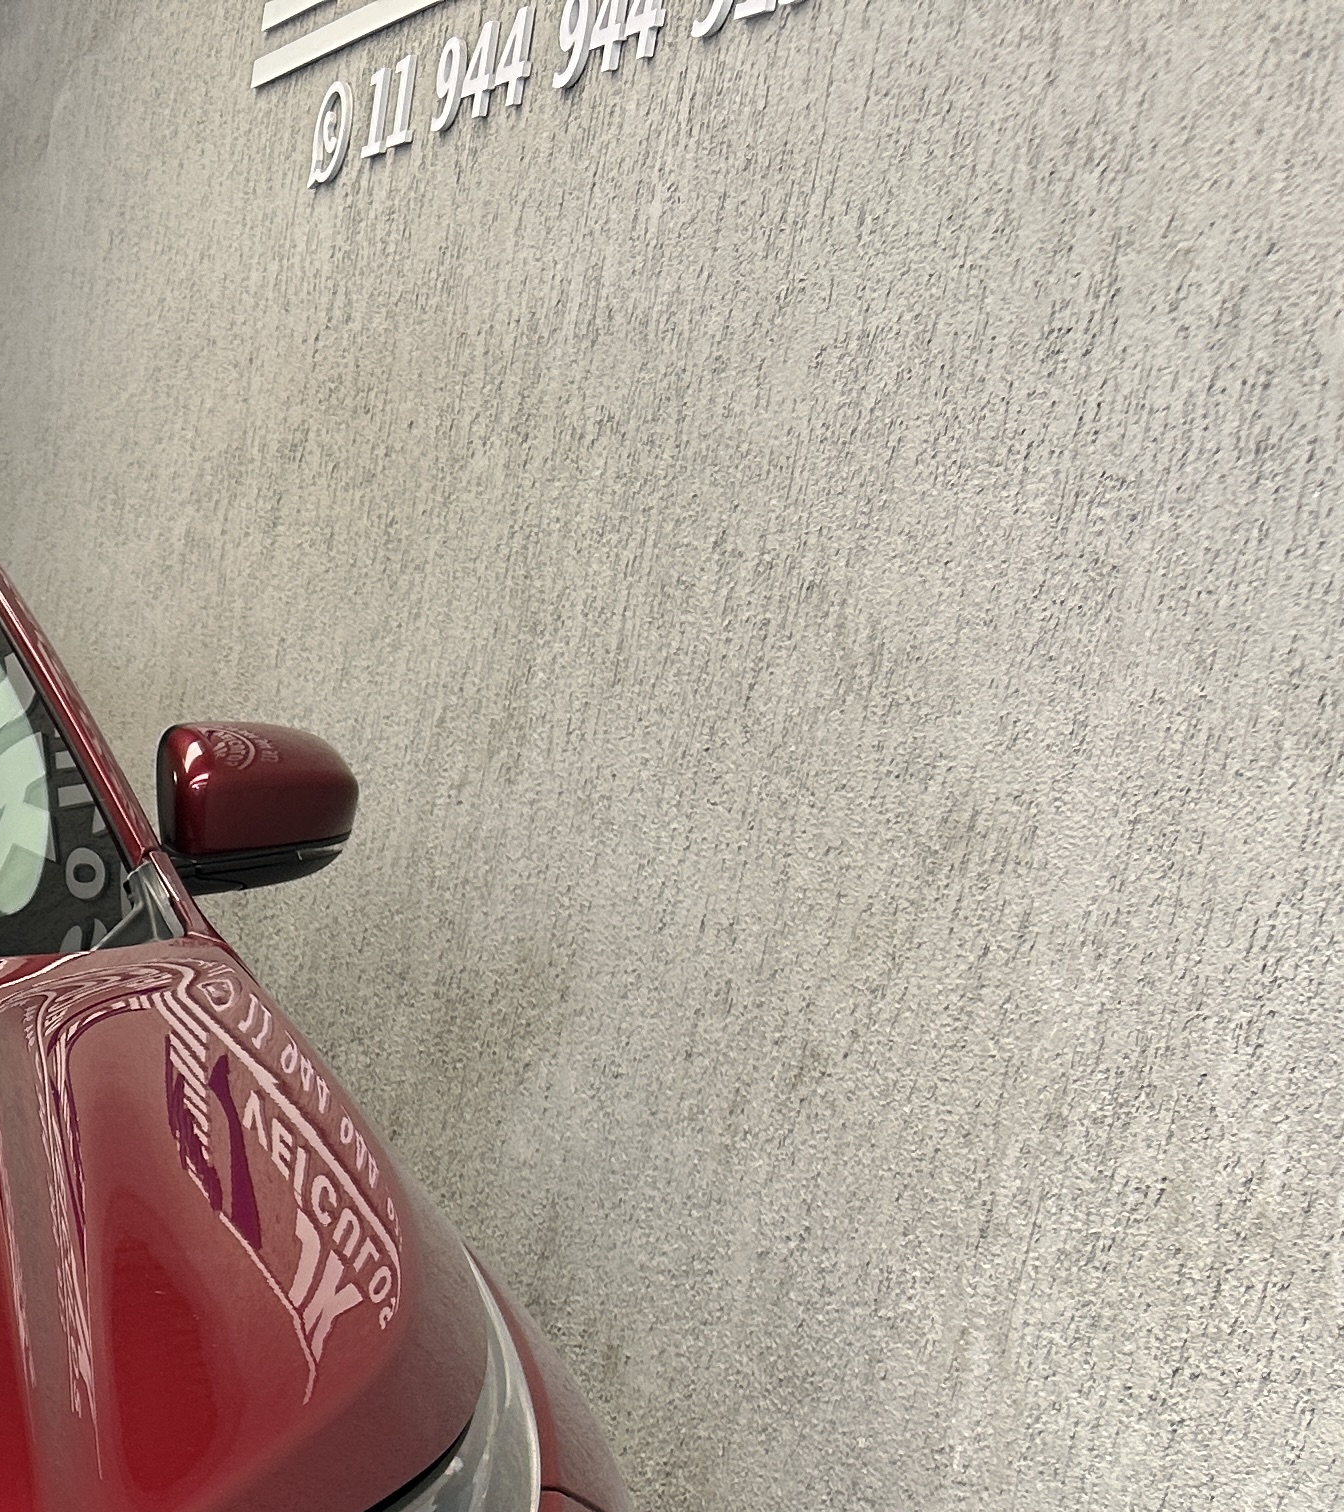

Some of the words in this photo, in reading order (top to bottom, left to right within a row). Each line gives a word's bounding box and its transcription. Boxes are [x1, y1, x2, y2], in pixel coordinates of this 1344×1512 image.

[361, 55, 418, 158] 11
[430, 6, 536, 132] 944
[552, 0, 666, 89] 944
